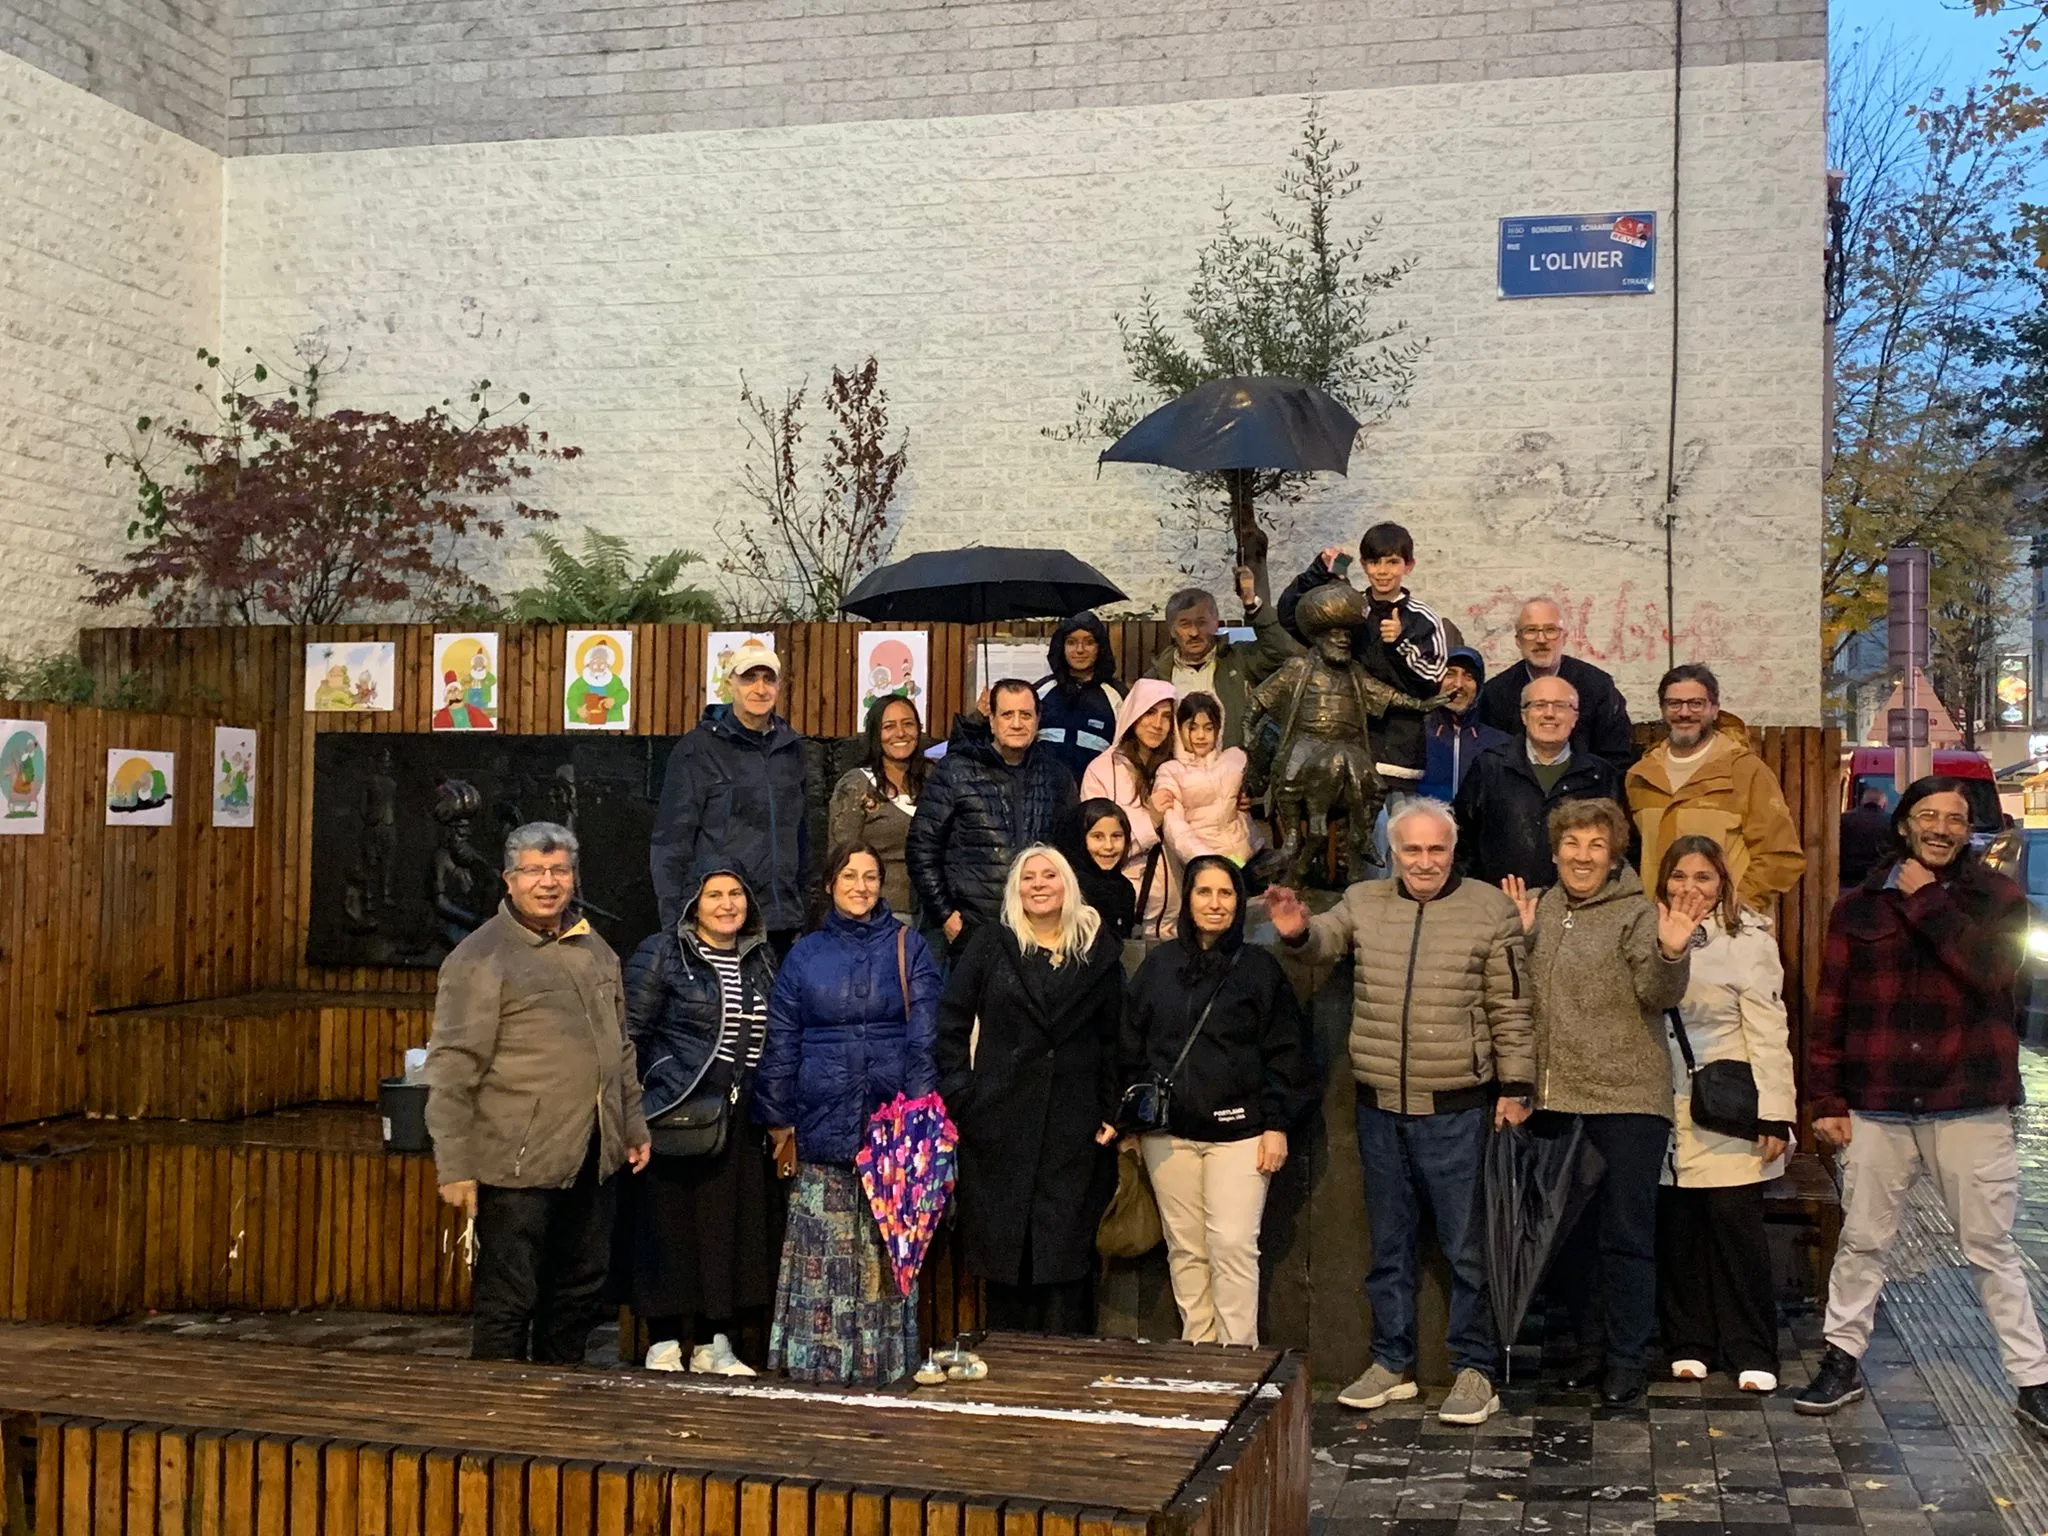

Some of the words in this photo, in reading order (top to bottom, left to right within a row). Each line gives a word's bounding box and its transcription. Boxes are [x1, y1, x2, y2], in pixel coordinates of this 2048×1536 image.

[1531, 225, 1573, 234] SCHAERBEEK
[1506, 243, 1521, 251] RUE
[1530, 251, 1623, 271] L'OLIVIER
[1622, 277, 1649, 286] STRAAT
[1213, 1107, 1245, 1116] PORTLAND
